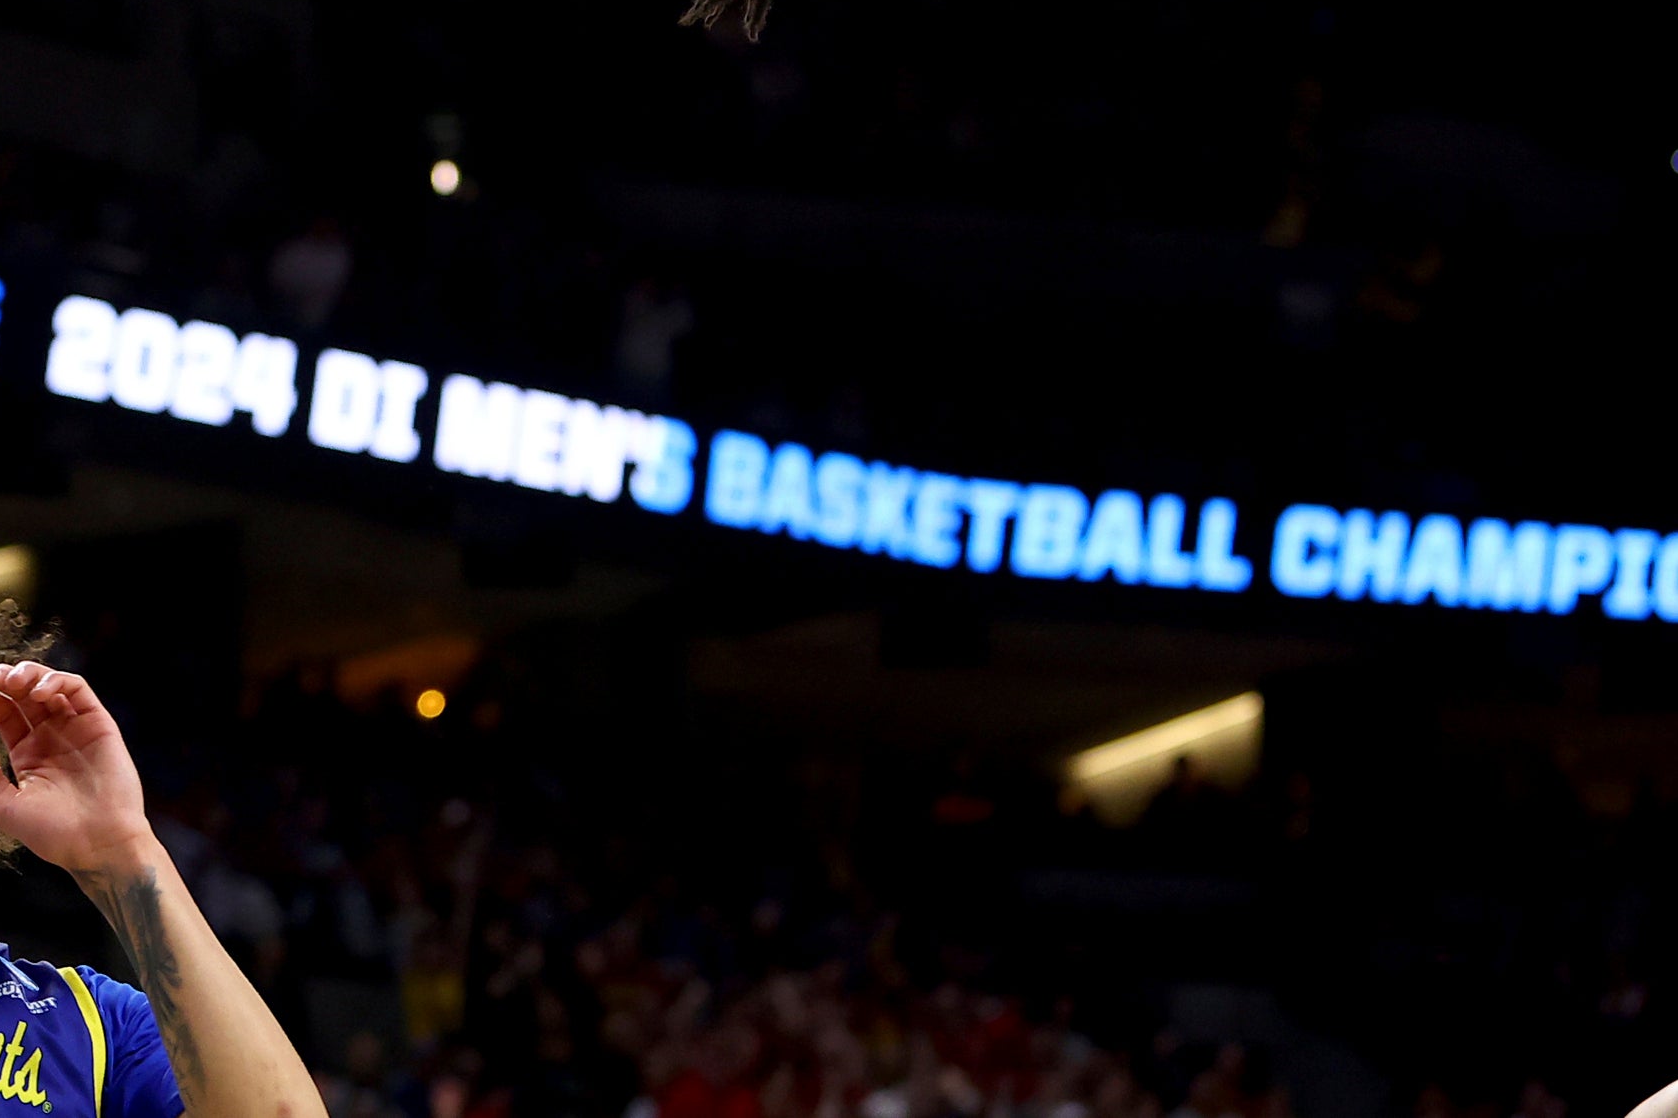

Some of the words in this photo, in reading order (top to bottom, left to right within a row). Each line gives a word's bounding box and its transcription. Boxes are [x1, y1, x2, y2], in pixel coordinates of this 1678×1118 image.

[46, 295, 299, 437] 2024
[308, 348, 428, 463] DI
[434, 373, 698, 515] MEN'S
[704, 429, 1253, 592] BASKETBALL
